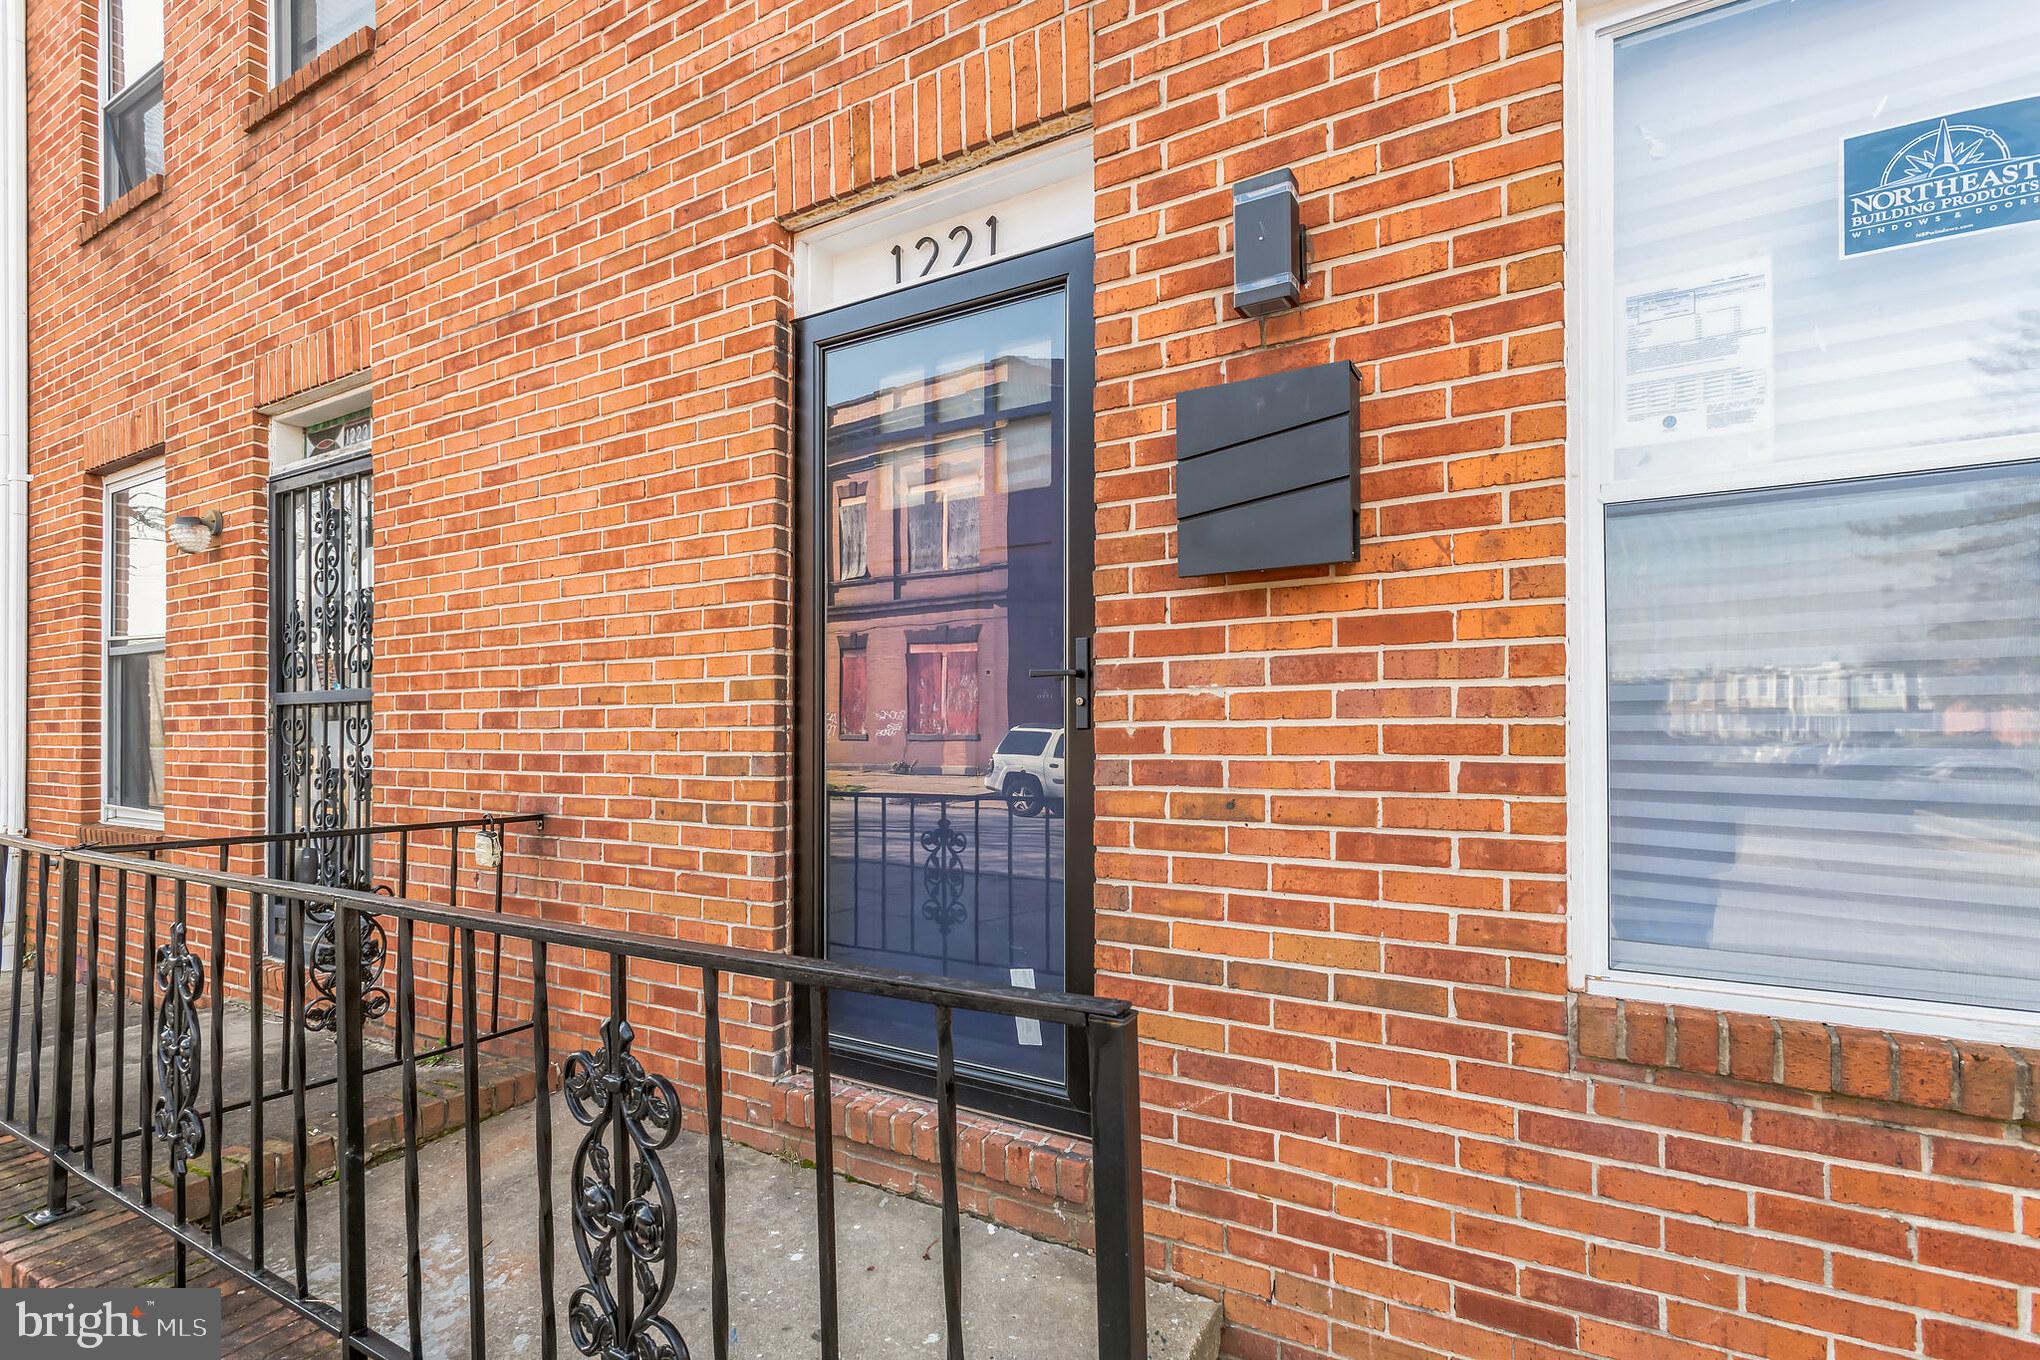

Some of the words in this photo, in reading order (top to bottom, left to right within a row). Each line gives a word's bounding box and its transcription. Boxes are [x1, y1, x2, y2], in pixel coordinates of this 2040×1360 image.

[1851, 159, 2040, 216] NORTHEAST
[1852, 202, 1936, 228] BUILDING
[1941, 180, 2040, 209] PRODUCTS
[1852, 215, 1941, 239] WINDOWS
[1954, 211, 1962, 219] &
[1975, 196, 2040, 215] DOORS
[890, 215, 998, 284] 1221
